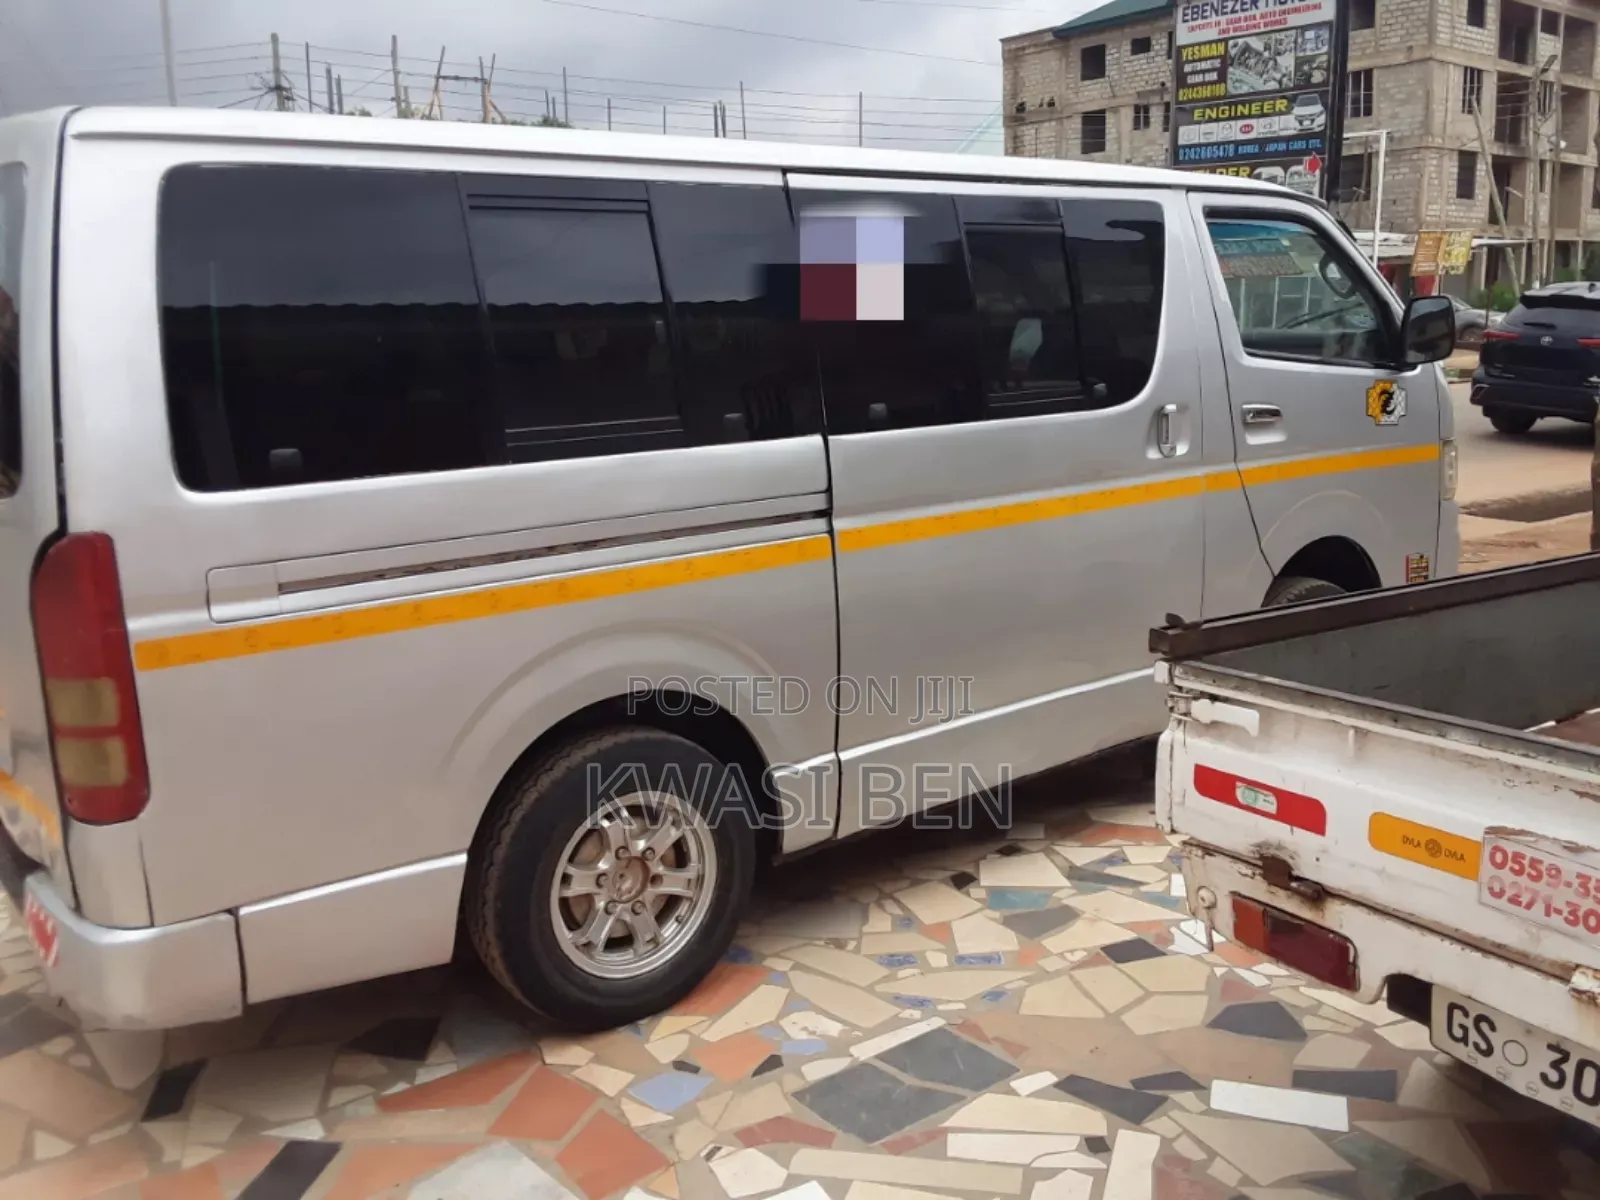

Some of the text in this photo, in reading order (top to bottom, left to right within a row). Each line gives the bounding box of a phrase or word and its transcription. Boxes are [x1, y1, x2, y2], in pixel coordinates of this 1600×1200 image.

[1181, 0, 1259, 23] EBENEZER
[1181, 42, 1225, 61] YESMAN
[1193, 99, 1289, 121] ENGINEER
[1446, 1001, 1497, 1059] GS
